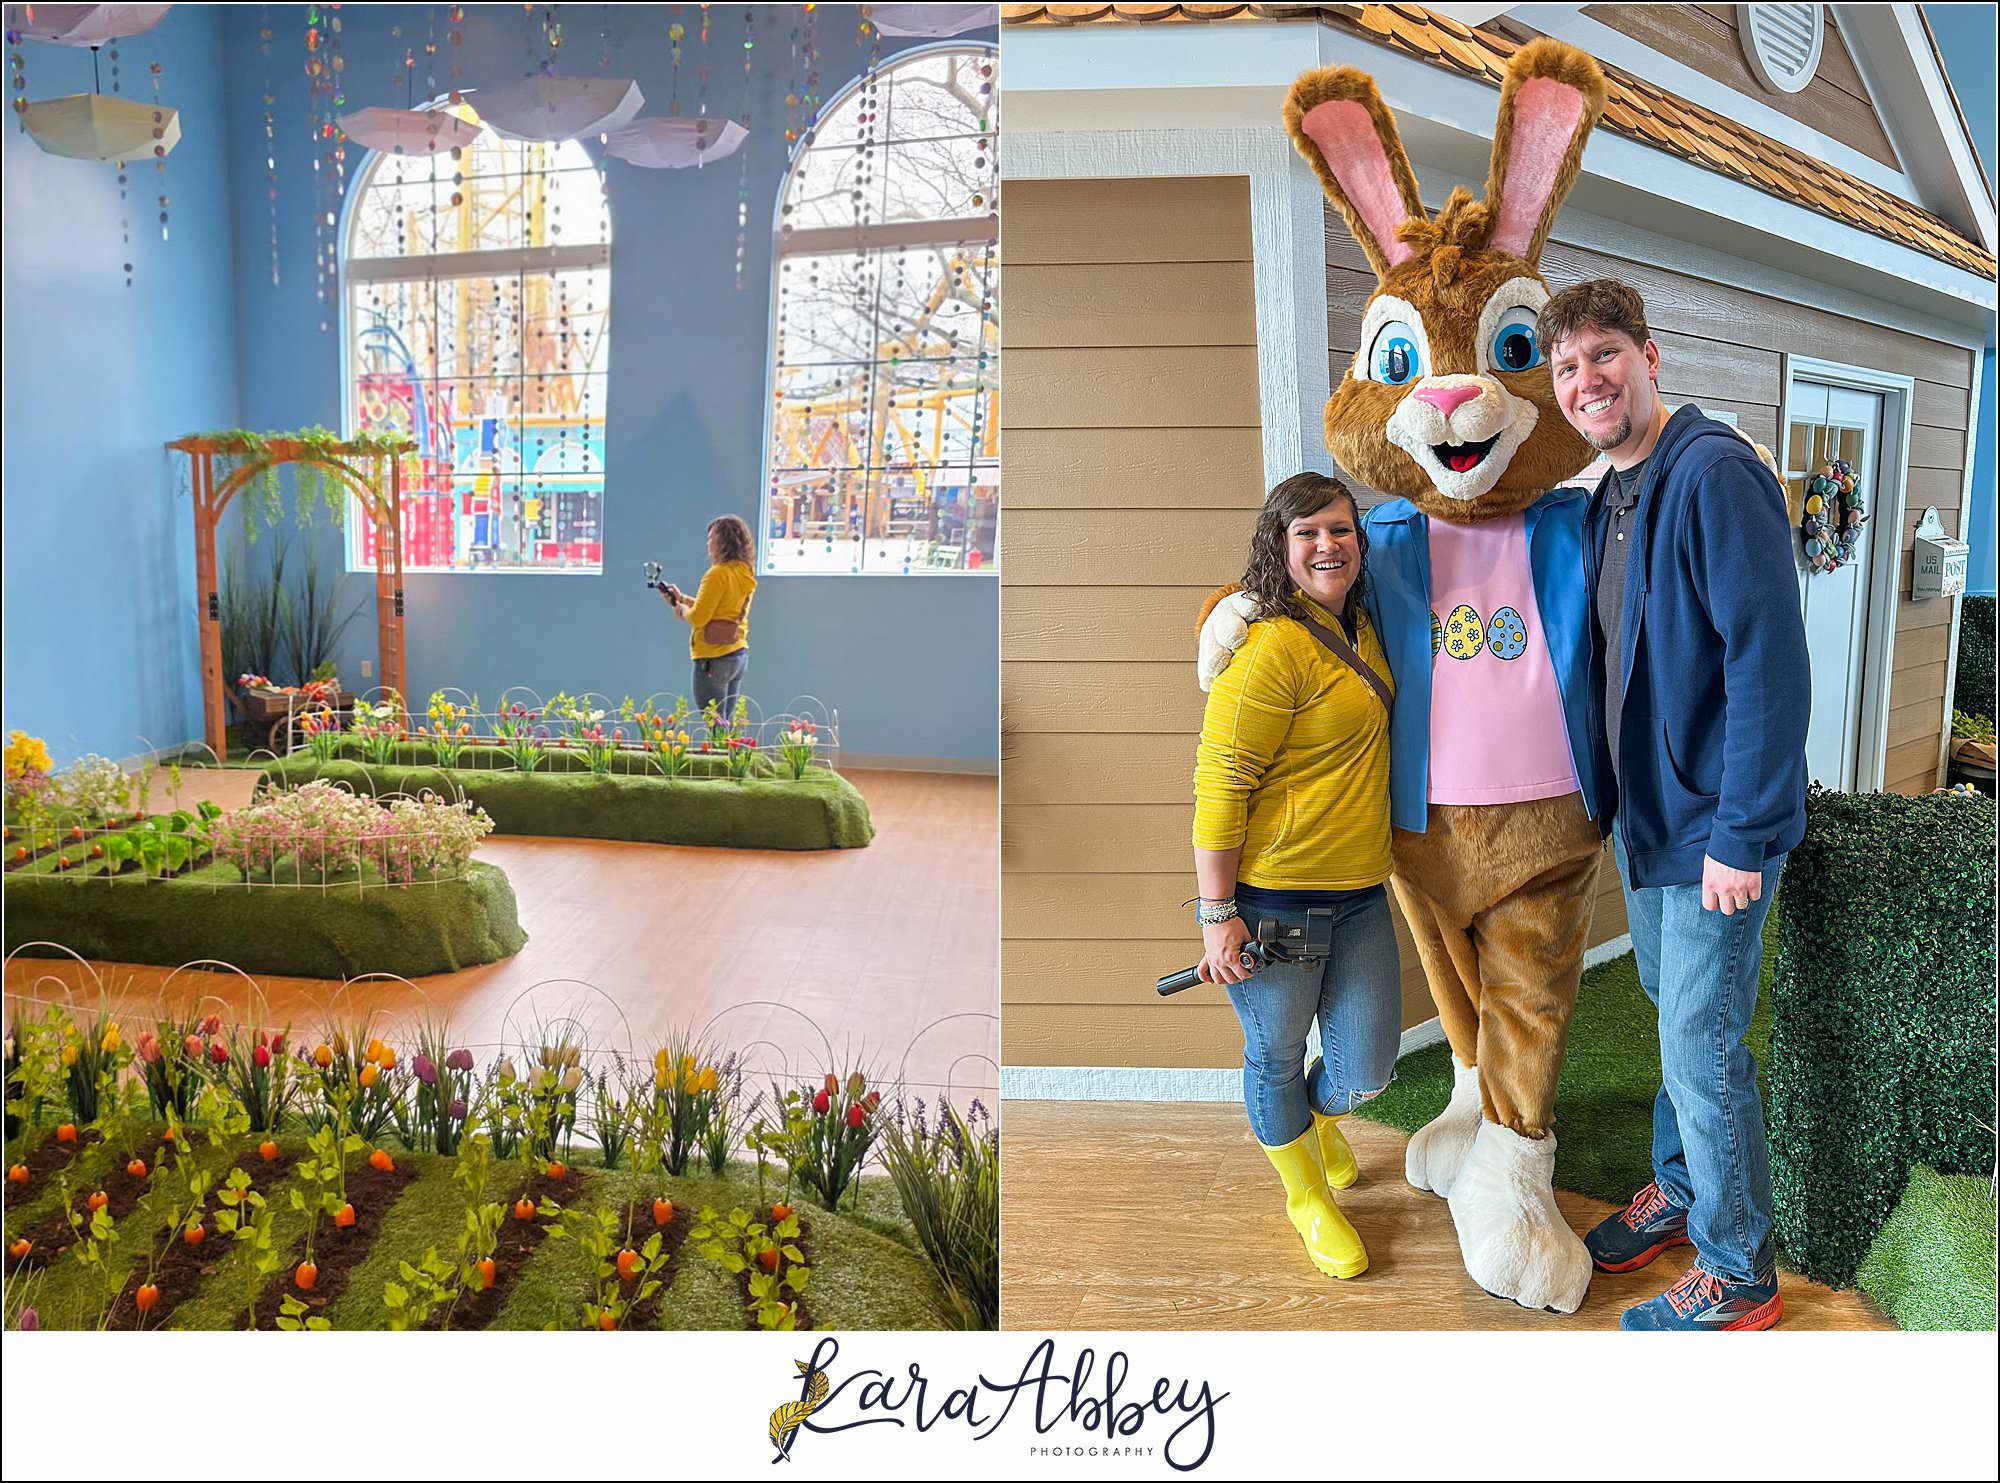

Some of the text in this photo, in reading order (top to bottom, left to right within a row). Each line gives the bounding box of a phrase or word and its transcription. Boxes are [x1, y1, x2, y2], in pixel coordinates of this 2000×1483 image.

[1926, 555, 1937, 564] US
[1920, 566, 1940, 574] MAIL
[1944, 560, 1965, 577] POST
